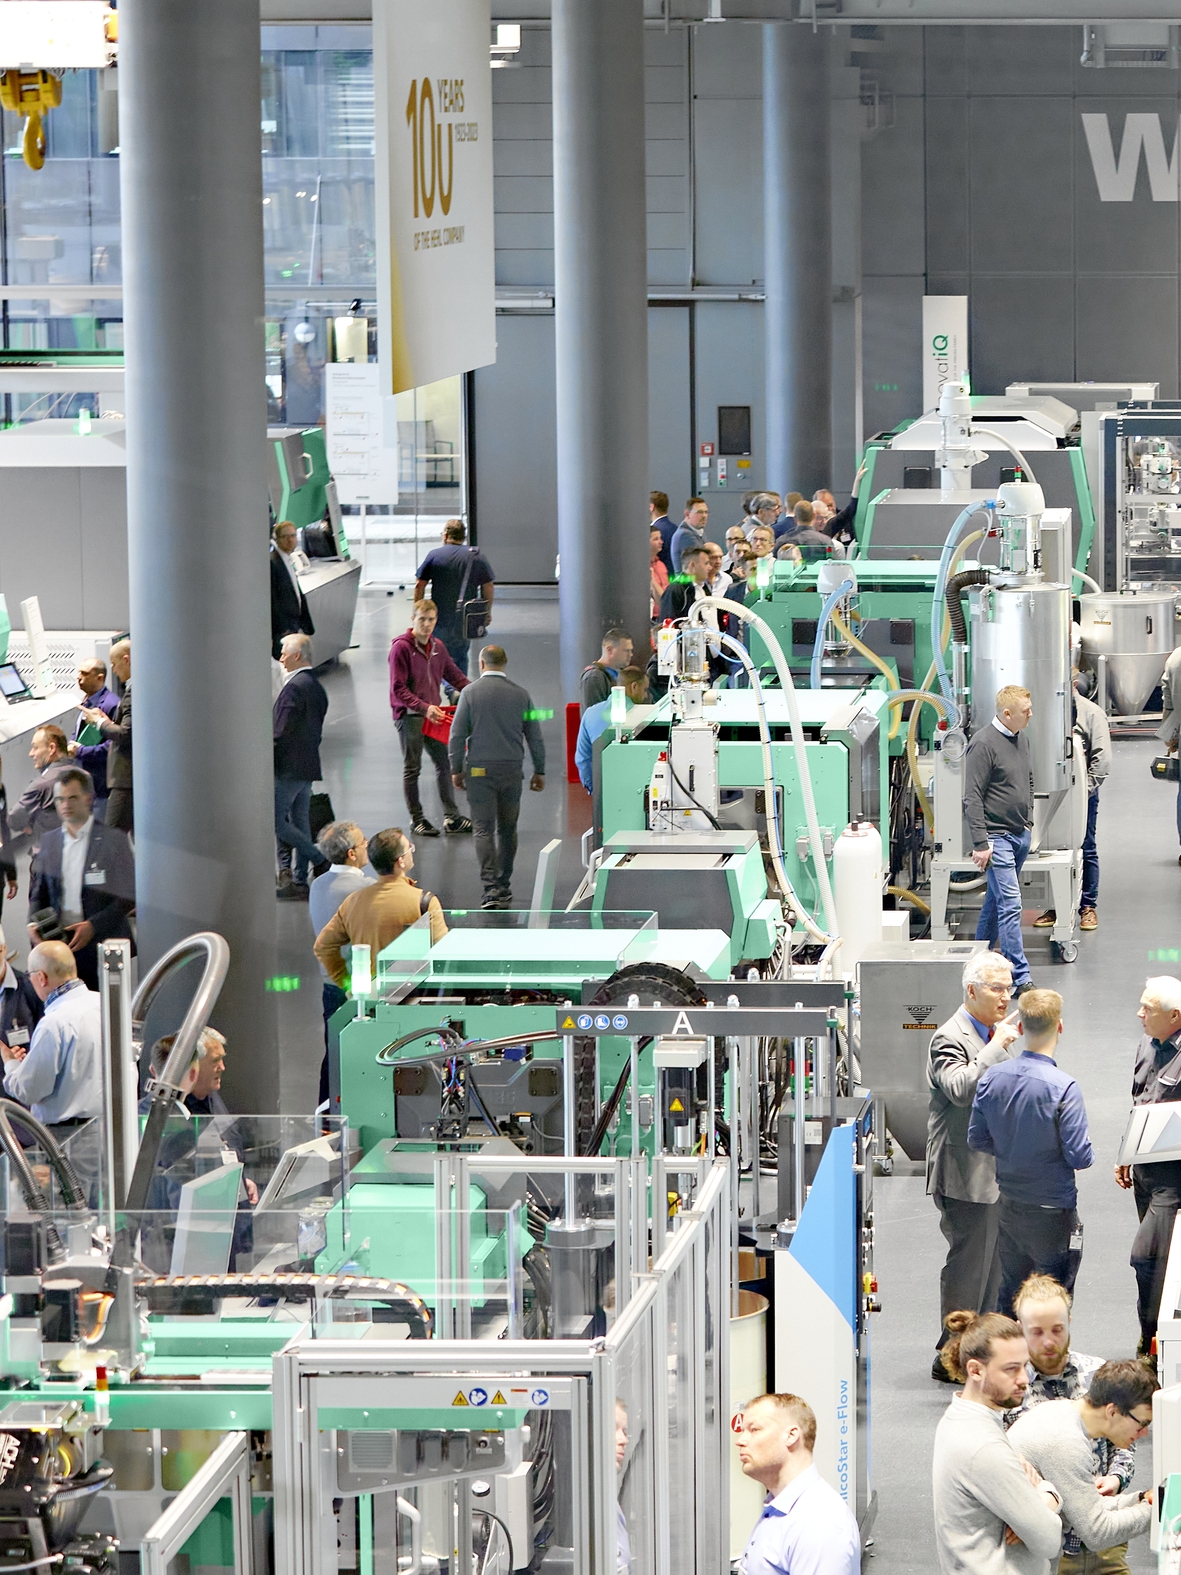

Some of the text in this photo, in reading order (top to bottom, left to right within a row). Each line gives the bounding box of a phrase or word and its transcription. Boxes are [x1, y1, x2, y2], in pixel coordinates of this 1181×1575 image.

[437, 79, 465, 113] YEARS
[671, 1011, 694, 1034] A
[837, 1380, 848, 1434] e-Flow
